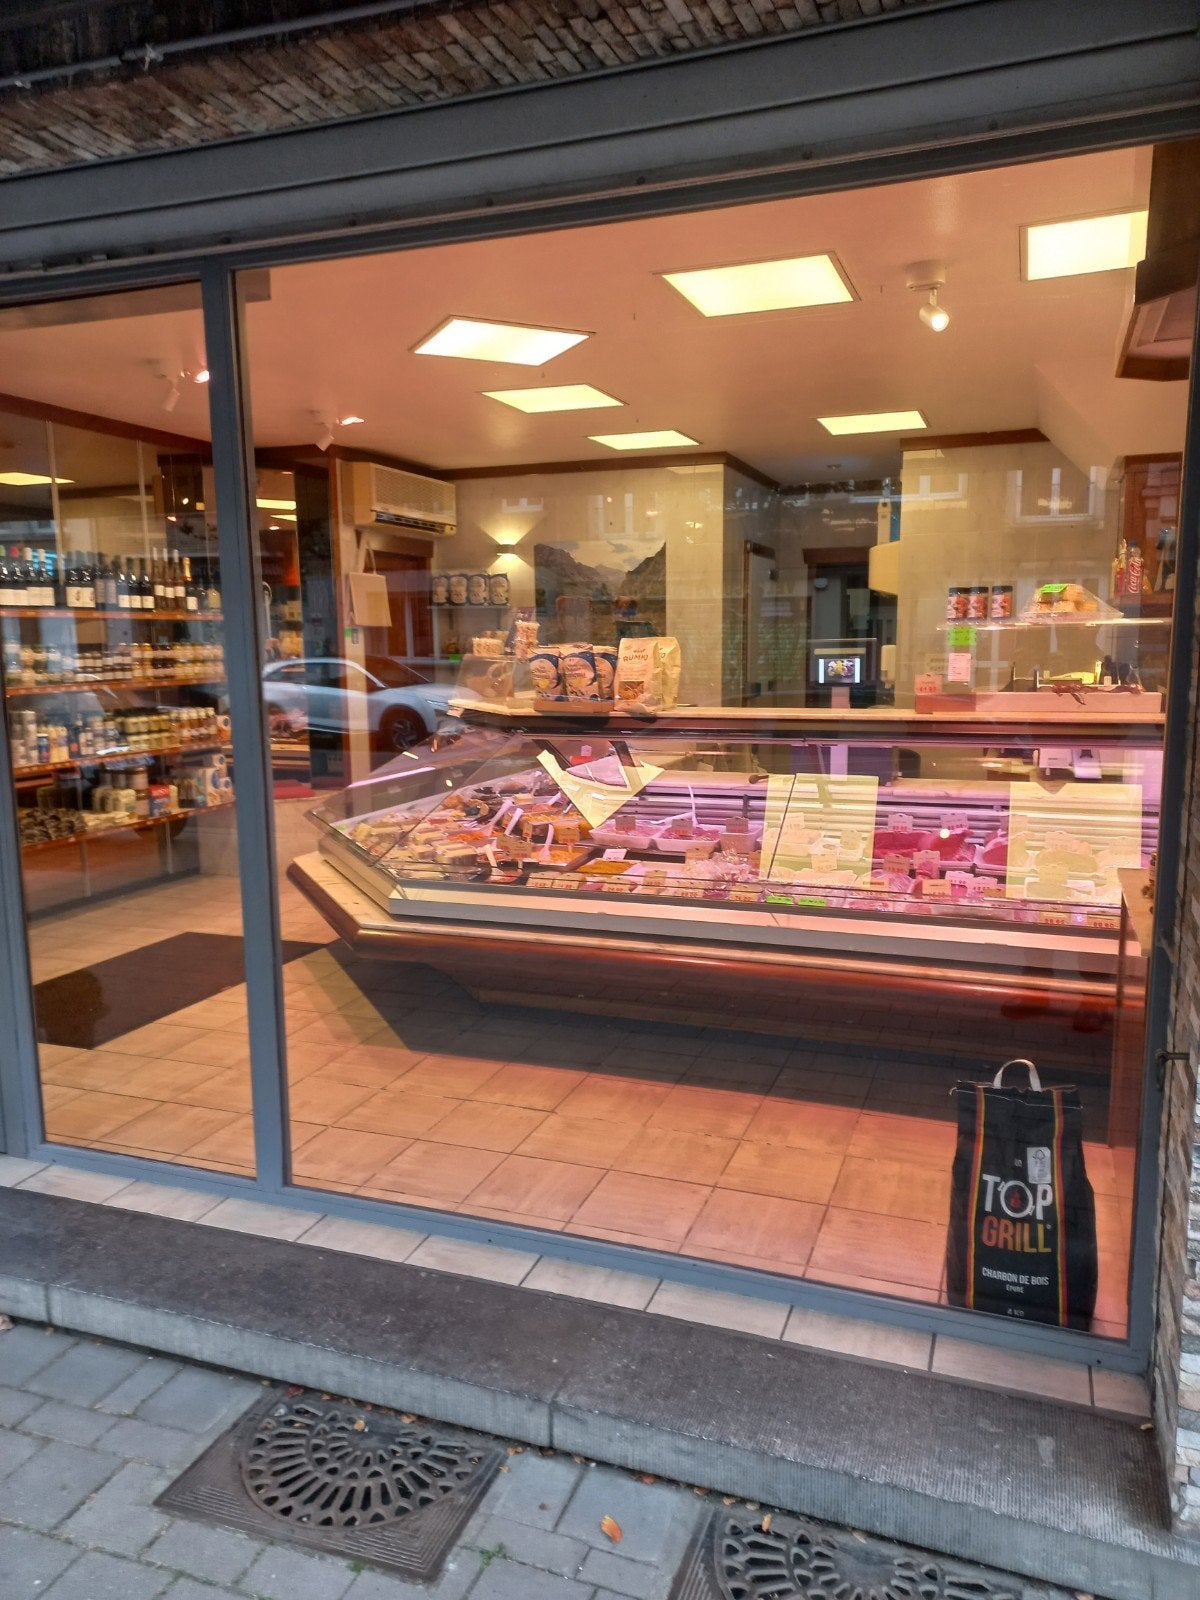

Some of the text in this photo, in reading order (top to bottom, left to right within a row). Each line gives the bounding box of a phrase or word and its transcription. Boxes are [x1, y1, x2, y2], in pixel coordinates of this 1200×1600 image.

[982, 1174, 1053, 1220] TOP
[982, 1216, 1052, 1253] GRILL
[982, 1266, 1049, 1286] CHARBON DE BOIS
